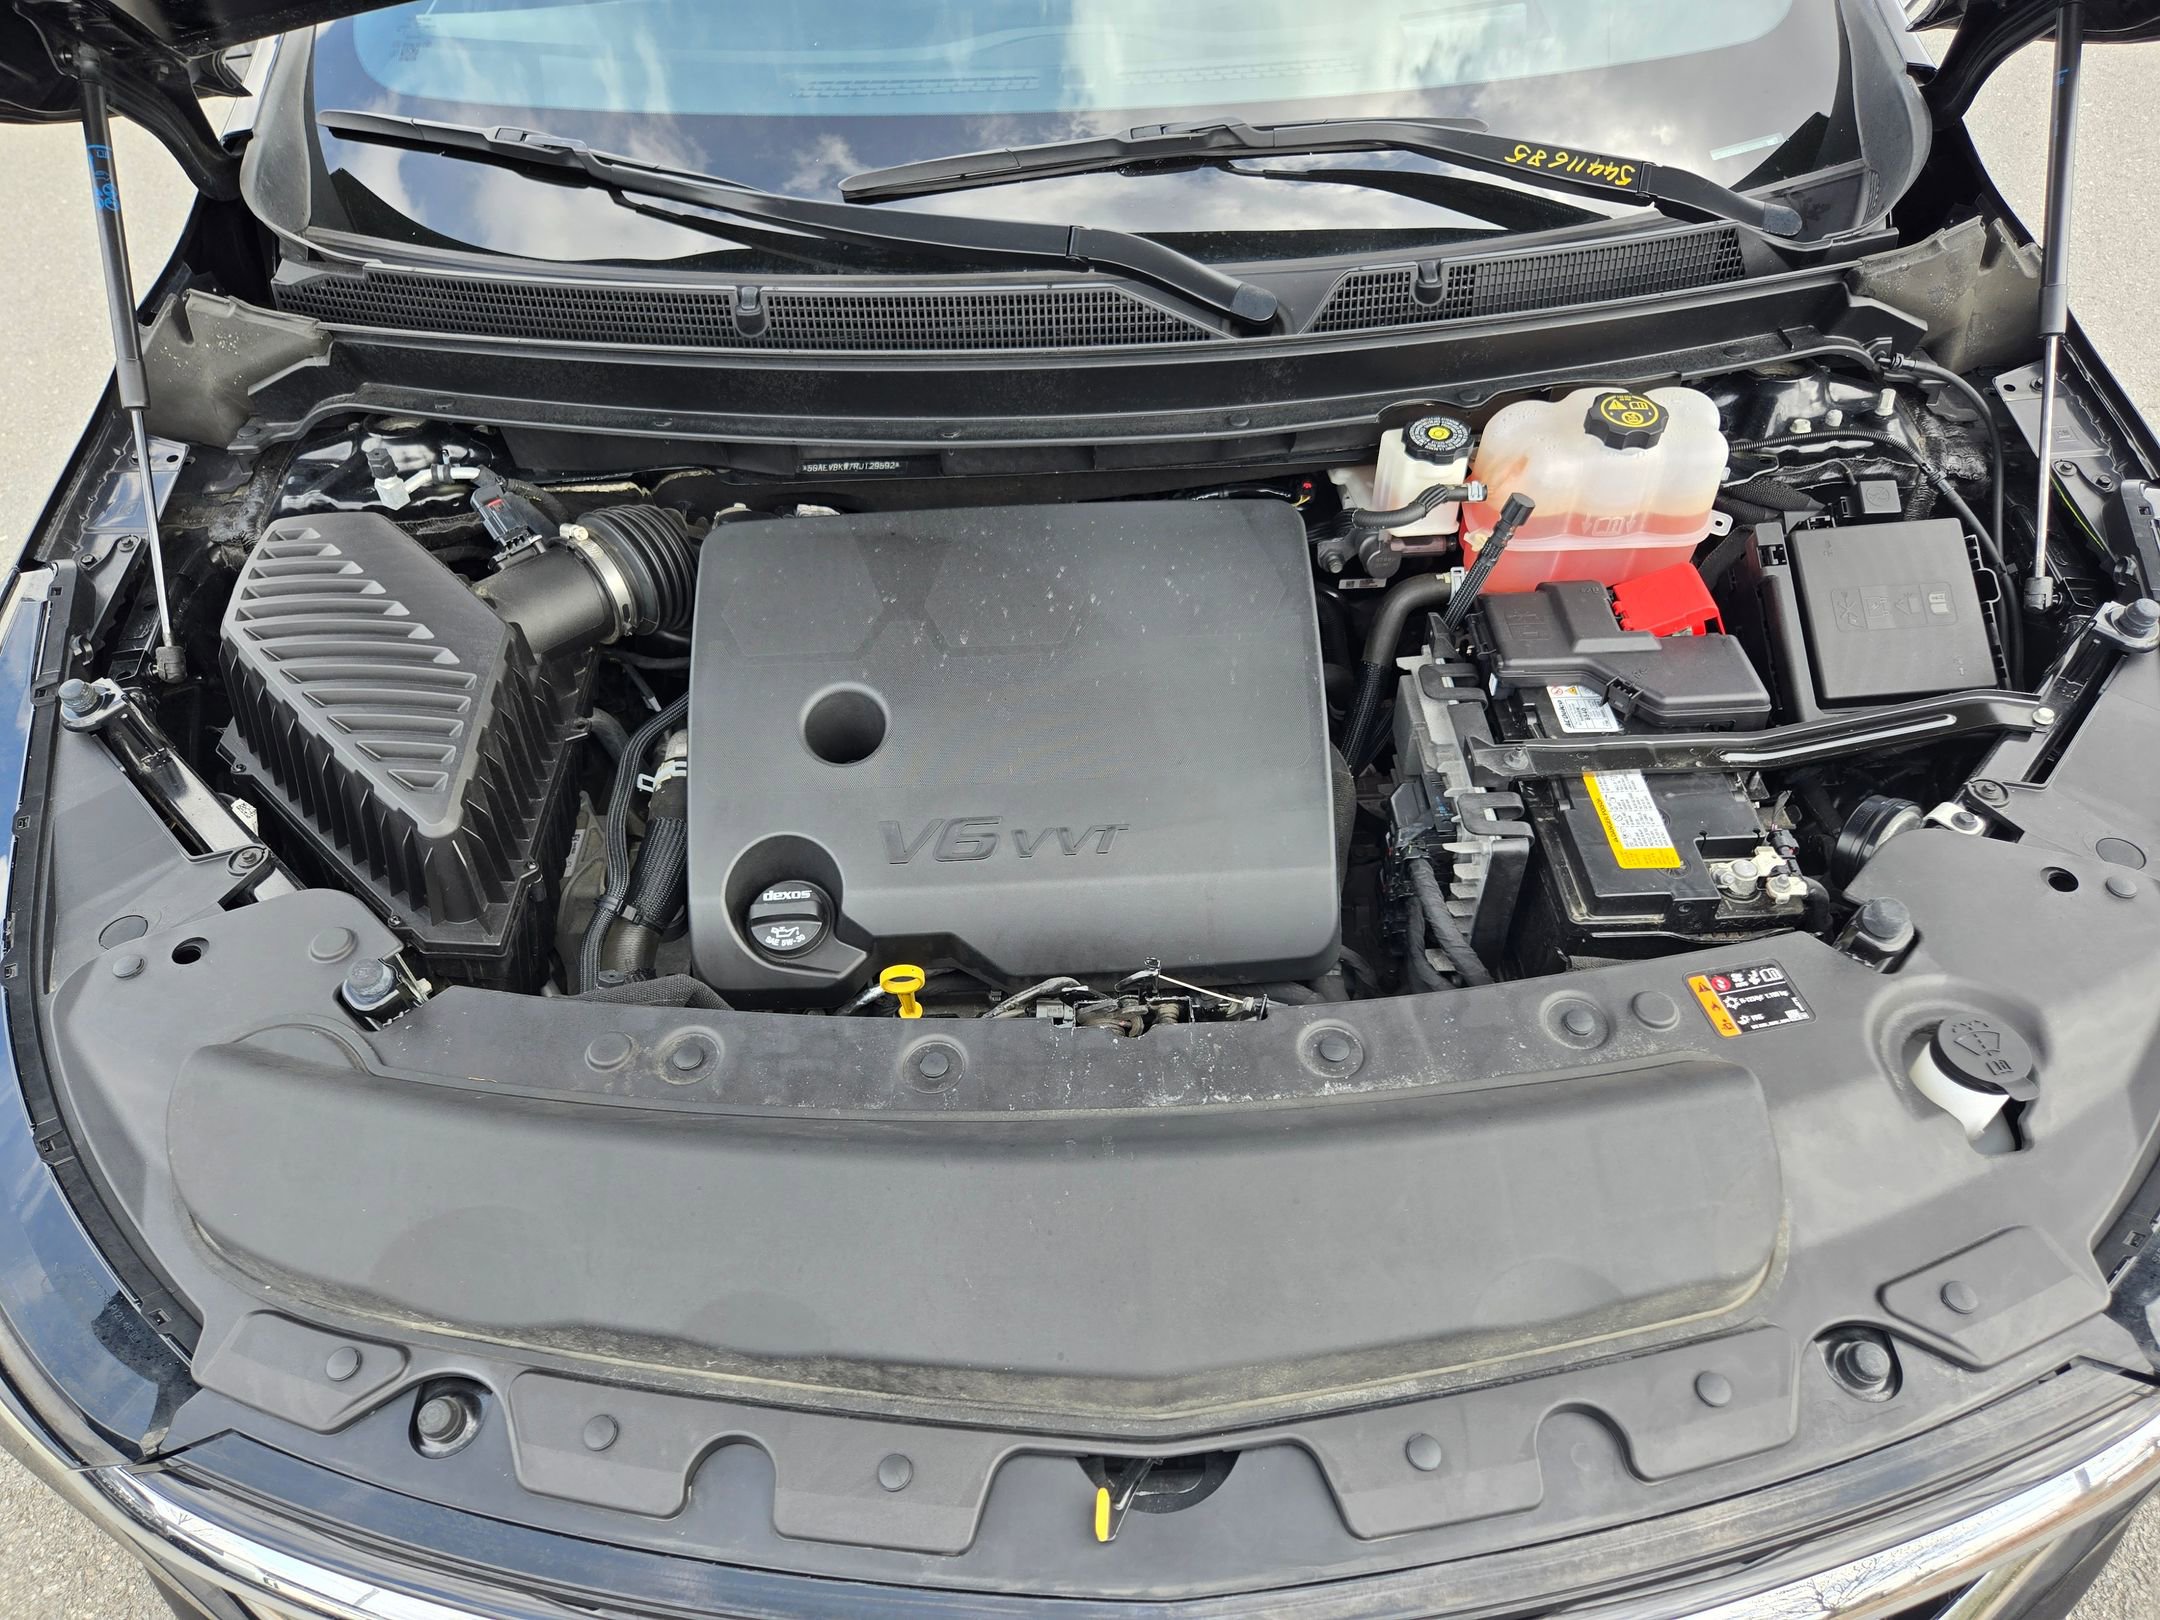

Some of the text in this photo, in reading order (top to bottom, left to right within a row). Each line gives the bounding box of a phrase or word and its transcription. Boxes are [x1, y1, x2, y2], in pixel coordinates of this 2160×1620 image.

[1505, 144, 1635, 186] 54411685
[878, 816, 1130, 864] V6 VVT
[763, 890, 812, 902] dexos
[765, 933, 806, 948] SAE 5W-30
